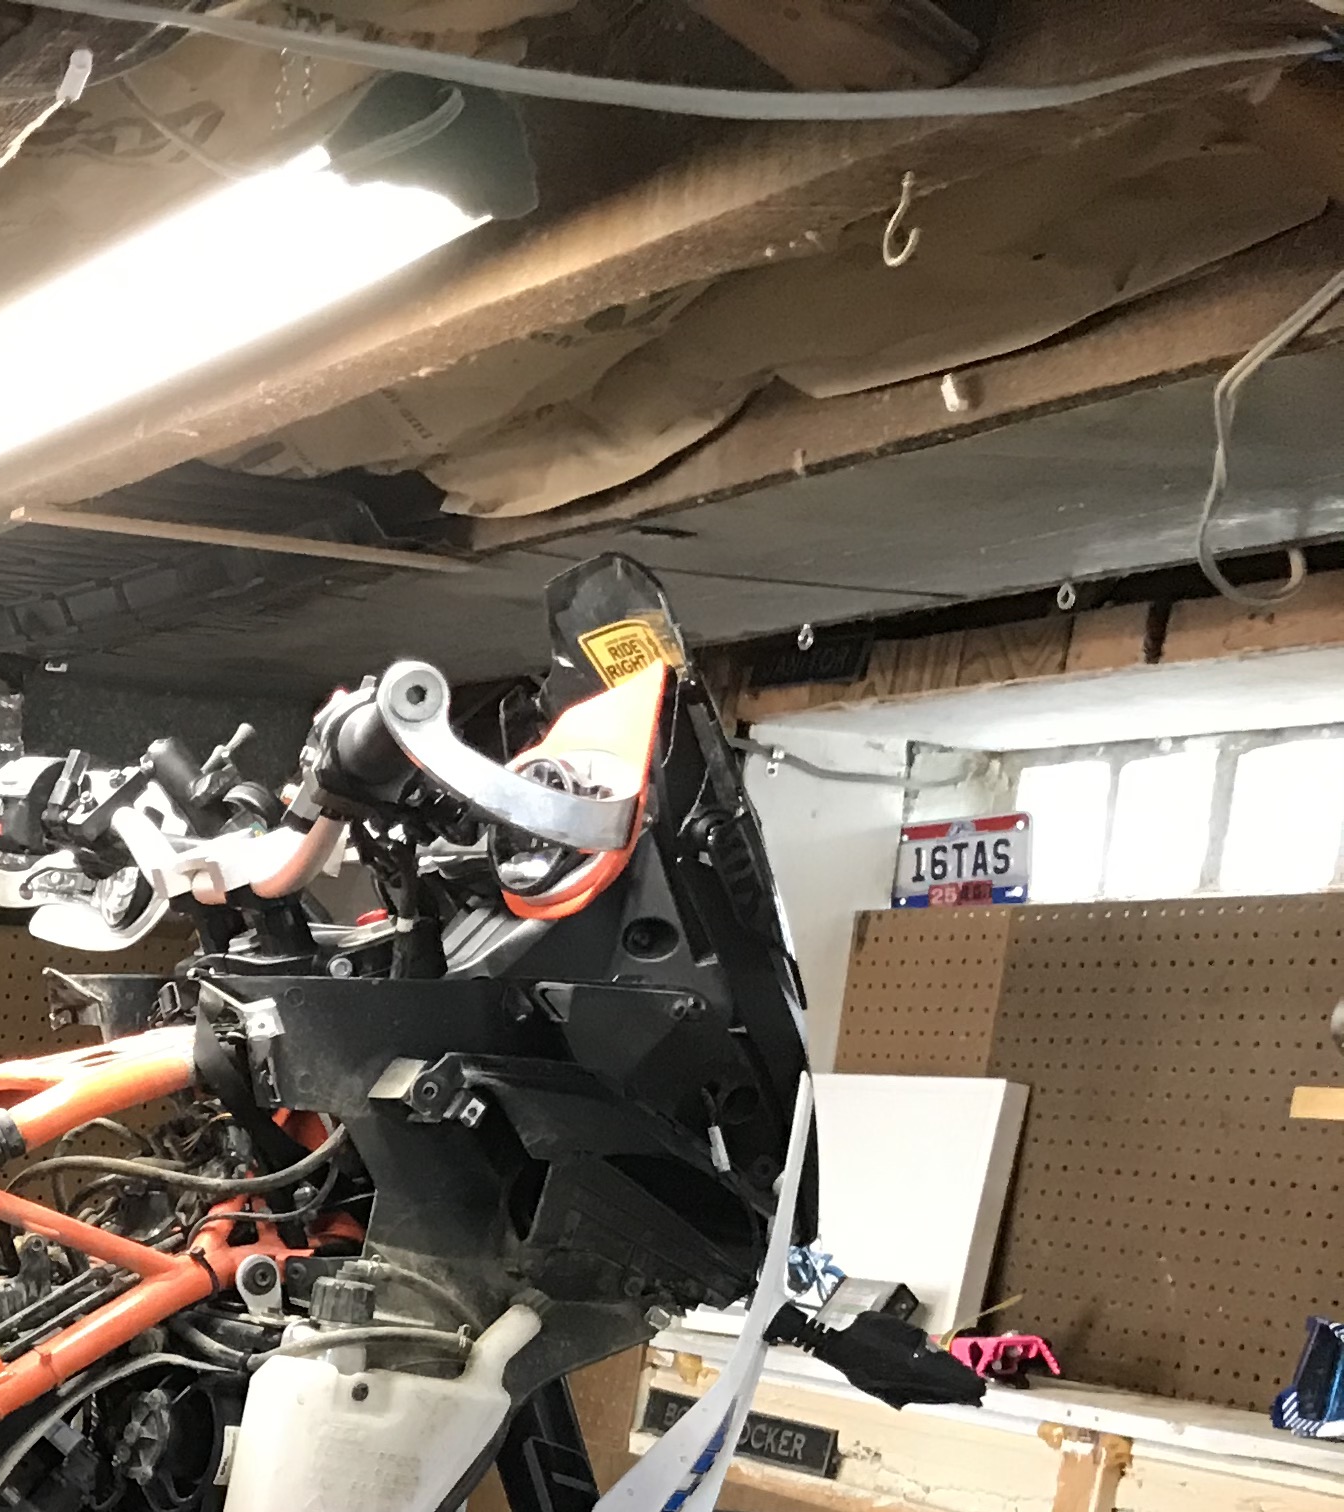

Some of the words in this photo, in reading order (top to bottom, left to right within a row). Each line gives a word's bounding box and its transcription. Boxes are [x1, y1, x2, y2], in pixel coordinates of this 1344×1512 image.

[607, 639, 641, 661] RIDE
[605, 654, 648, 680] RIGHT
[912, 838, 1011, 883] 16TAS
[929, 885, 959, 905] 25
